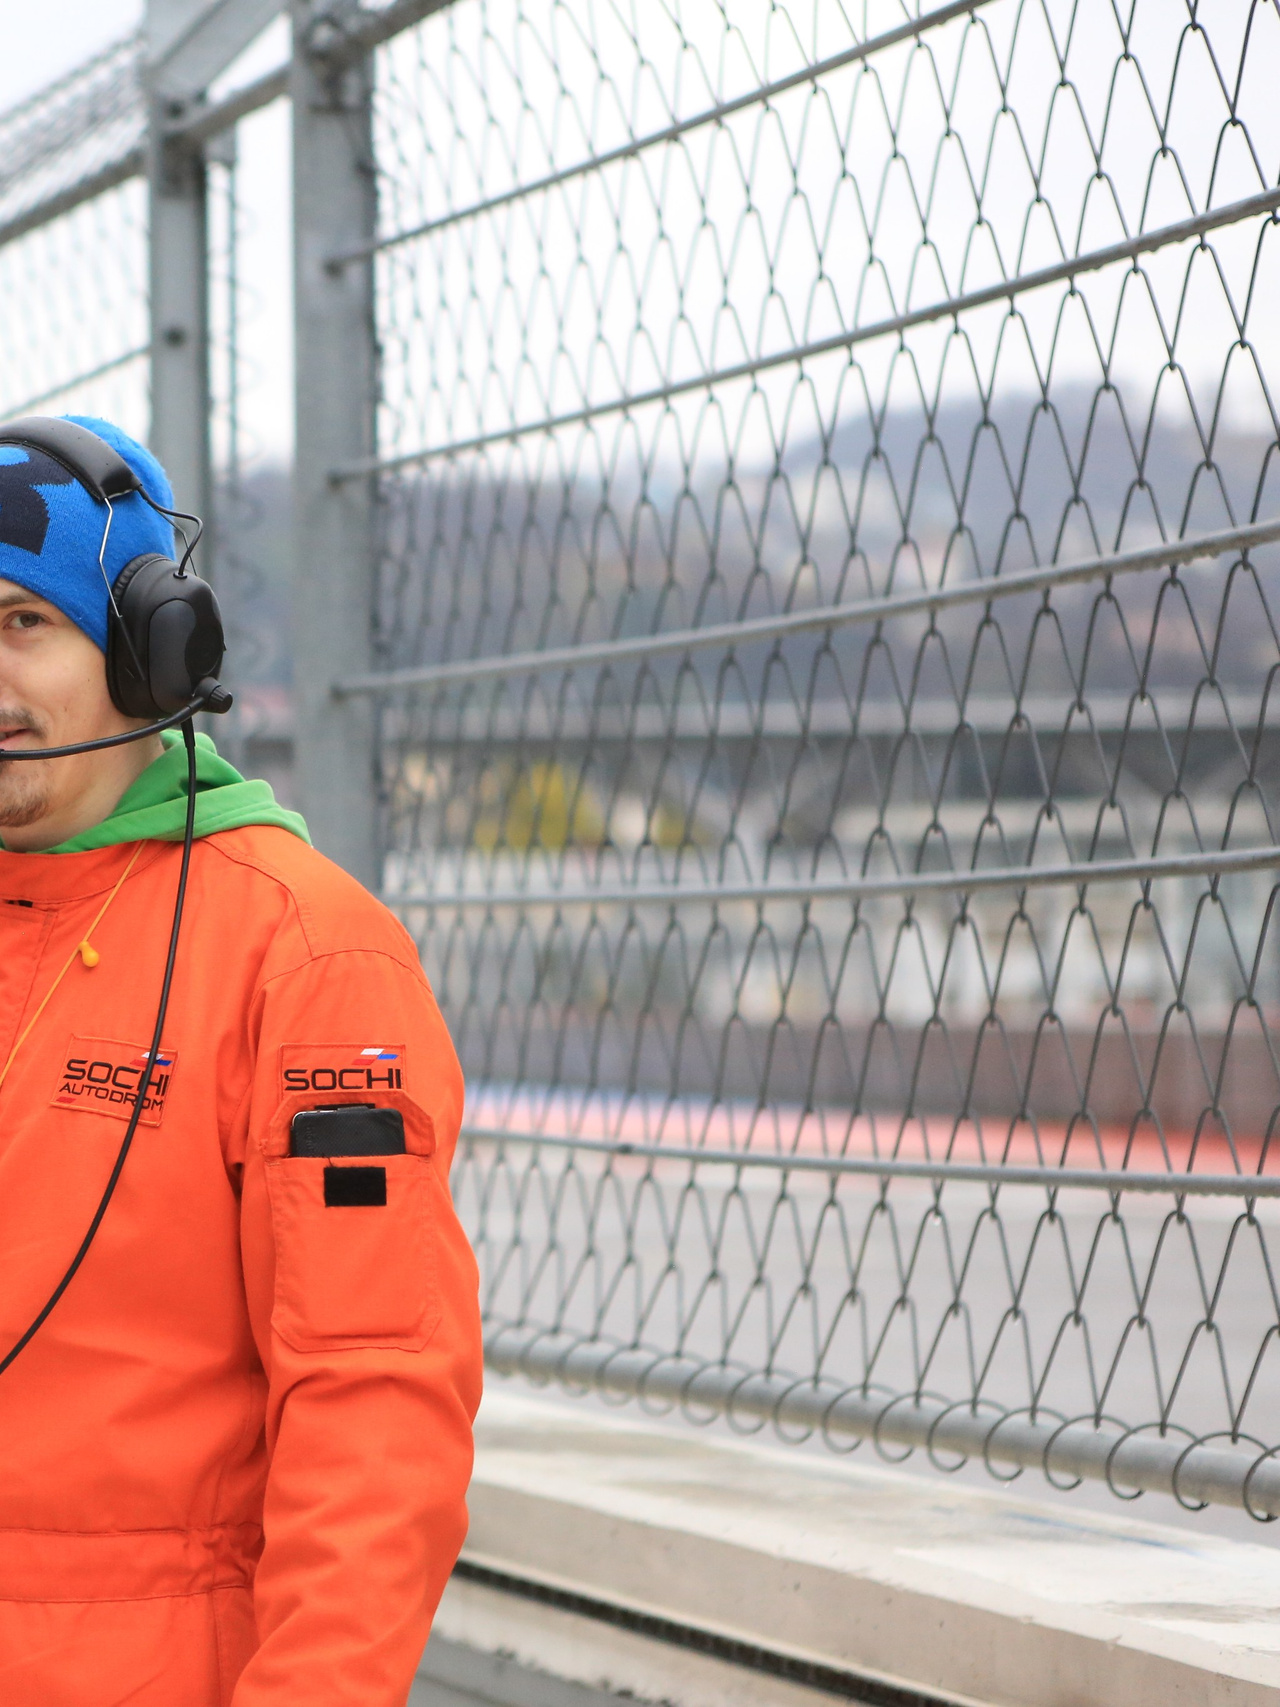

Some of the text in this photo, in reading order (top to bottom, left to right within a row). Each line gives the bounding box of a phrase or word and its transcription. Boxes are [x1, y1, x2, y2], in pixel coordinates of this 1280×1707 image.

[63, 1059, 170, 1096] SOCHI
[284, 1068, 402, 1091] SOCHI
[59, 1082, 164, 1112] AUTODROM
